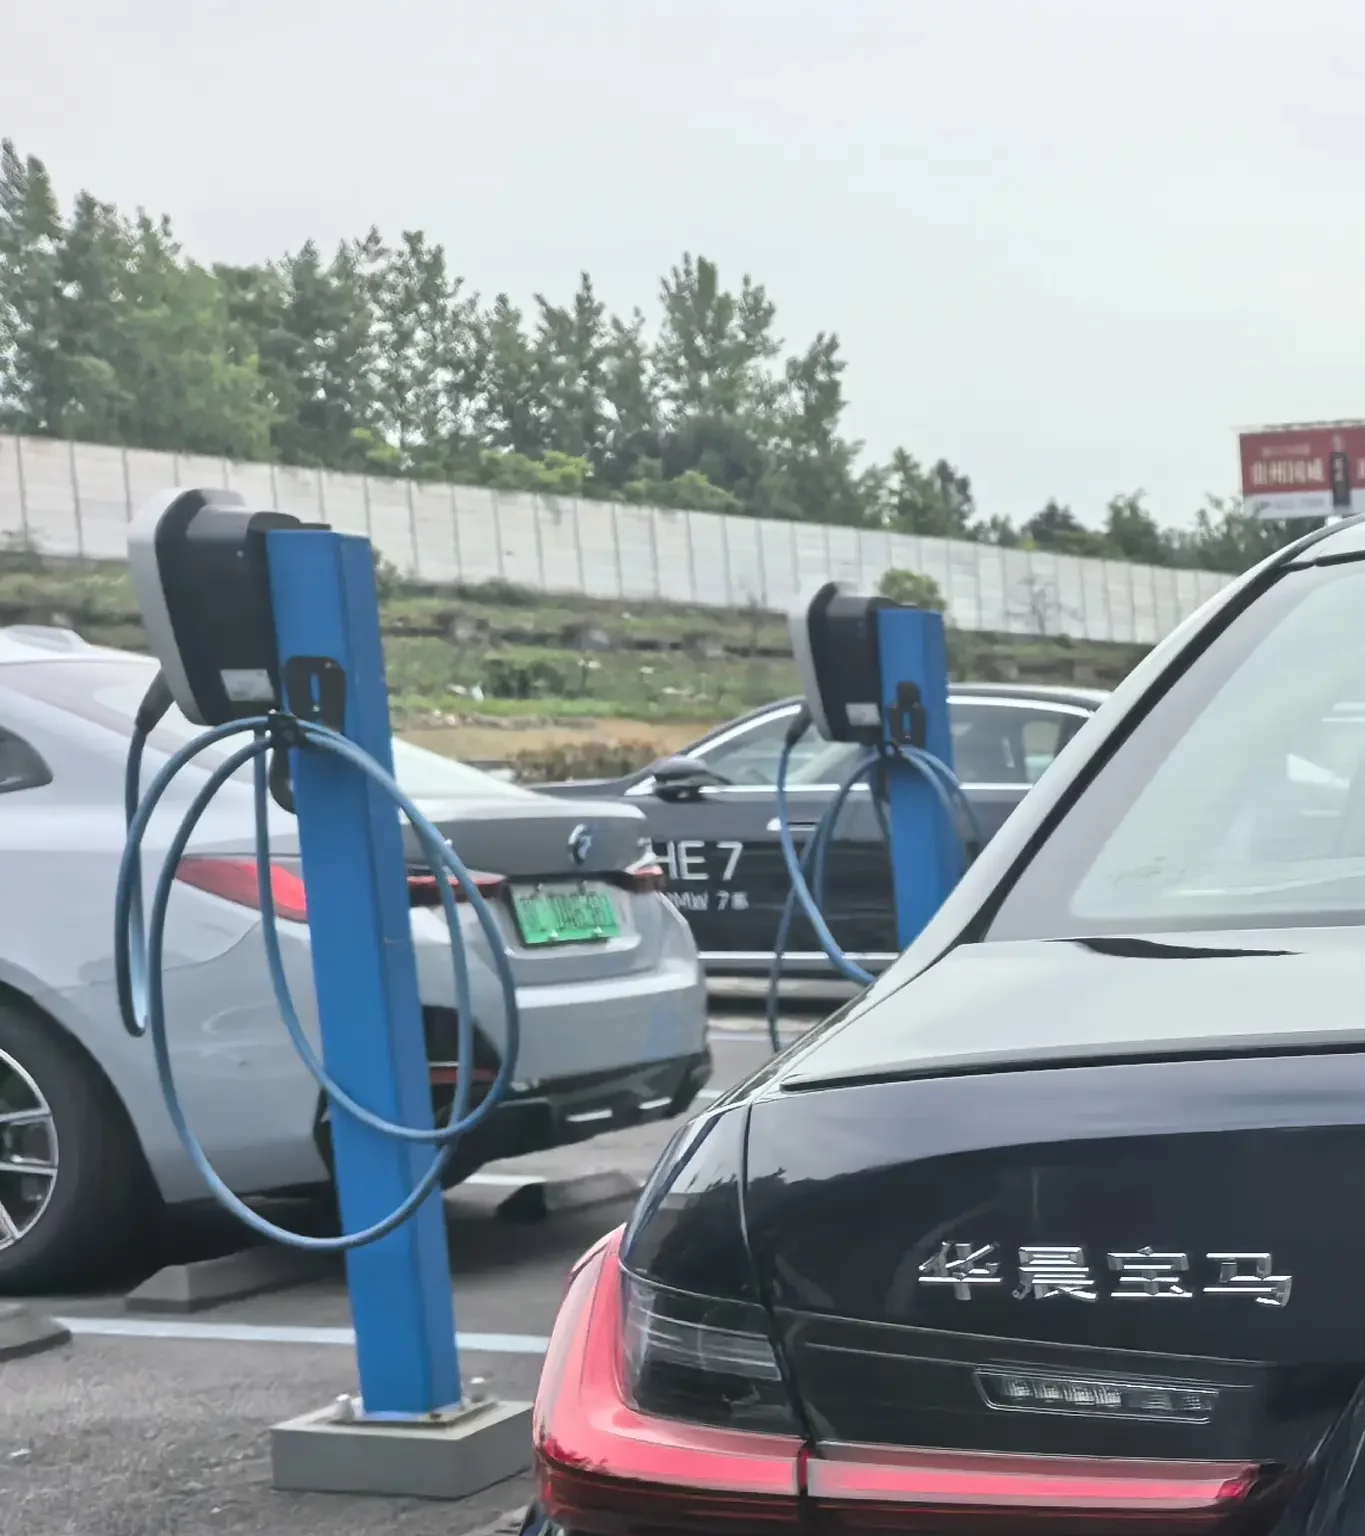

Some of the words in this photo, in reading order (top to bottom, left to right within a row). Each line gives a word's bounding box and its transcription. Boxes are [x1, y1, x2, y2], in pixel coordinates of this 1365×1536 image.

[716, 840, 743, 881] 7
[918, 1240, 1294, 1307] 华晨宝马
